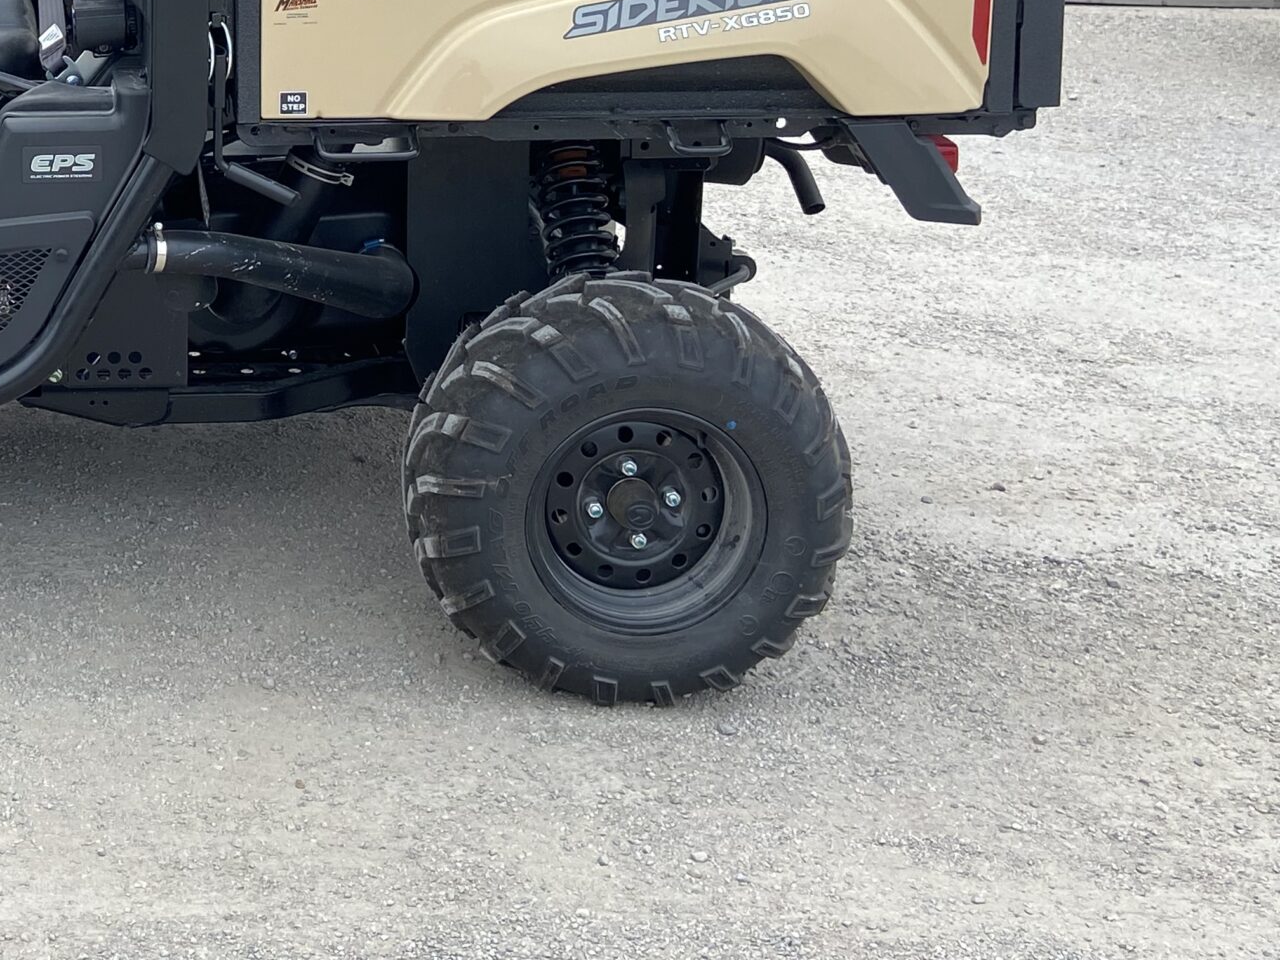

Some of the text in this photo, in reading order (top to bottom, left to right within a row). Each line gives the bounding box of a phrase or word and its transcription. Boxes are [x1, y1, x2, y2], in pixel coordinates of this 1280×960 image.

[658, 3, 811, 43] RTV-XG850
[287, 94, 301, 102] NO
[281, 103, 305, 111] STEP
[30, 153, 96, 172] EPS
